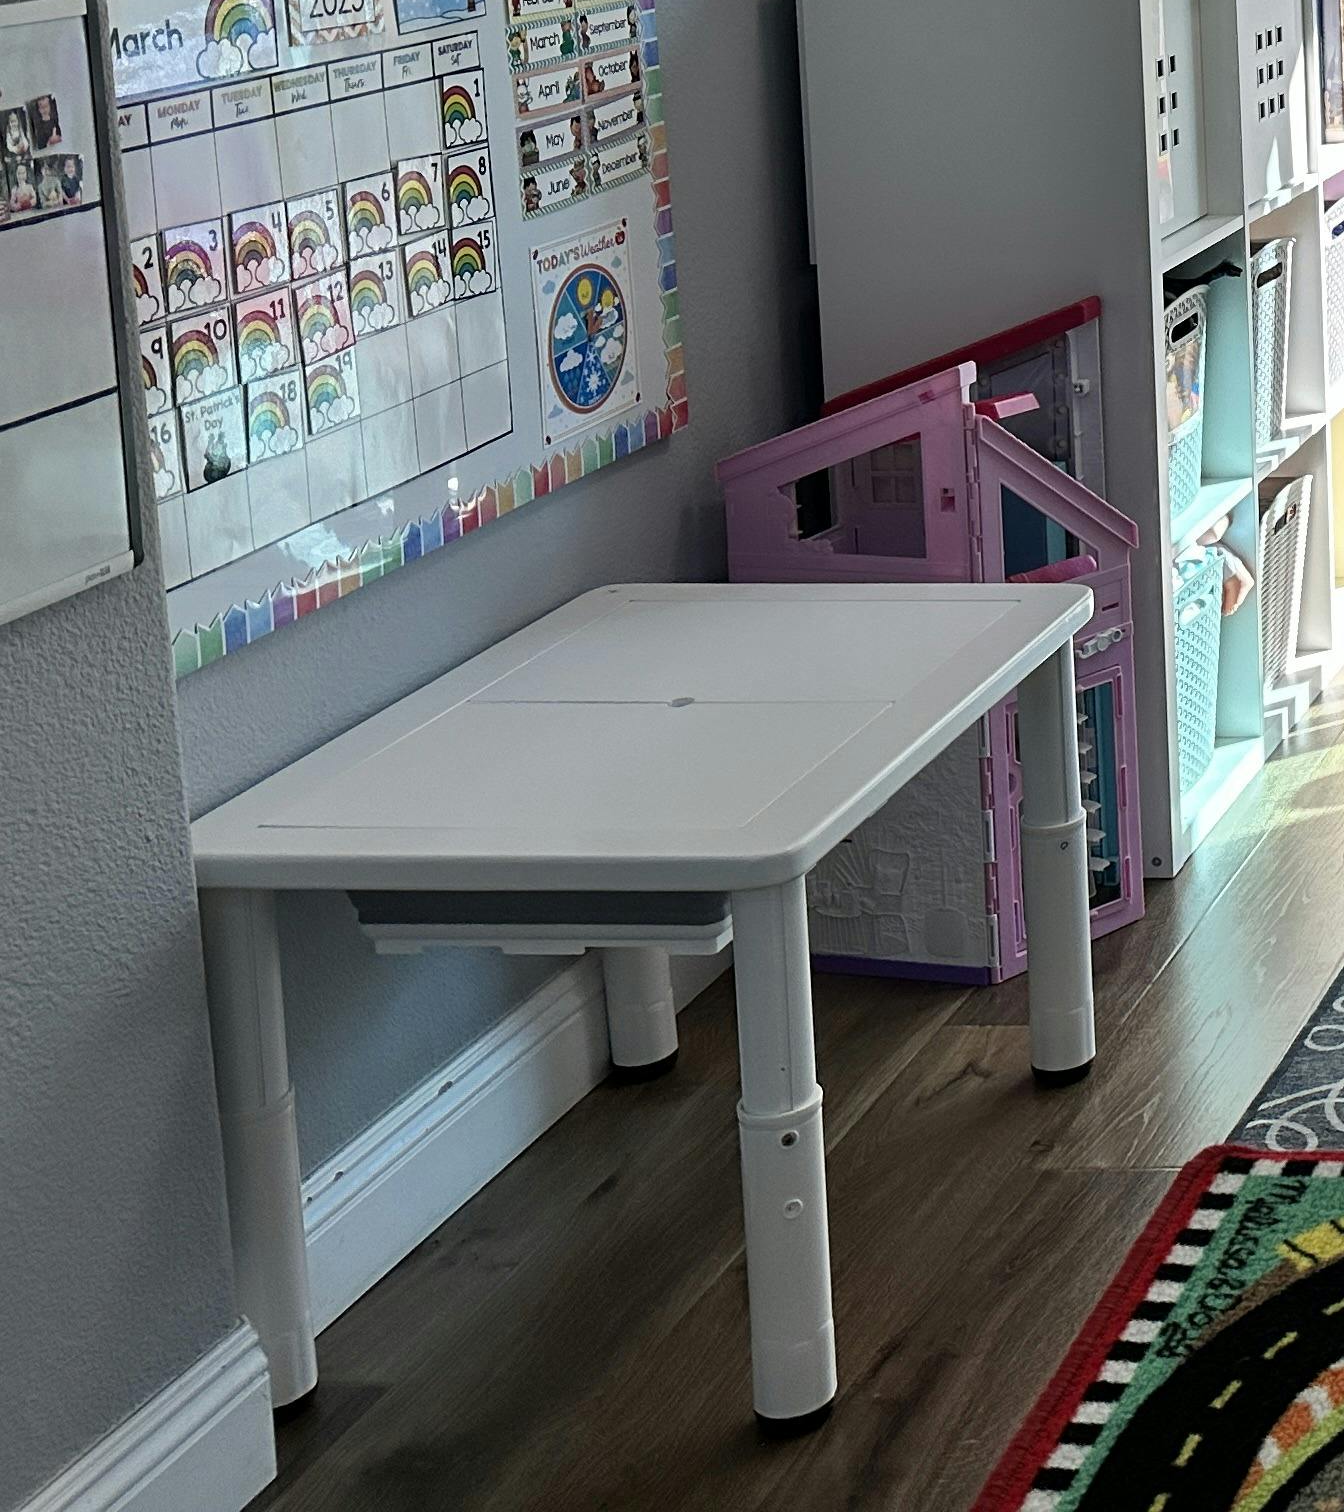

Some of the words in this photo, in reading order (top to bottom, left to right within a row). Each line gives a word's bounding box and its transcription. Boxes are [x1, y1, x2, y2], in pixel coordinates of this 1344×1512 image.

[588, 17, 627, 36] September
[530, 31, 561, 52] March
[157, 99, 201, 119] MONDAY
[221, 85, 263, 103] TUESDAY
[333, 60, 377, 79] THURSDAY
[393, 50, 421, 67] FRIDAY
[437, 38, 474, 56] SATURDAY
[598, 59, 628, 77] October
[472, 77, 481, 98] 1
[538, 80, 560, 100] April
[597, 109, 636, 131] November
[545, 132, 565, 150] May
[601, 151, 638, 175] December
[547, 178, 570, 196] June
[141, 246, 155, 270] 2
[208, 228, 219, 252] 3
[271, 210, 282, 233] 4
[325, 200, 335, 221] 5
[380, 181, 391, 202] 6
[430, 162, 438, 183] 7
[477, 155, 487, 176] 8
[536, 245, 580, 276] TODAY'S
[579, 235, 616, 259] Weather
[150, 336, 164, 360] 9
[203, 318, 228, 341] 10
[269, 297, 286, 322] 11
[327, 279, 344, 306] 12
[378, 260, 394, 282] 13
[431, 237, 447, 261] 14
[476, 229, 491, 250] 15
[150, 422, 172, 445] 16
[280, 379, 297, 403] 18
[335, 350, 353, 374] 19
[204, 418, 224, 432] Day
